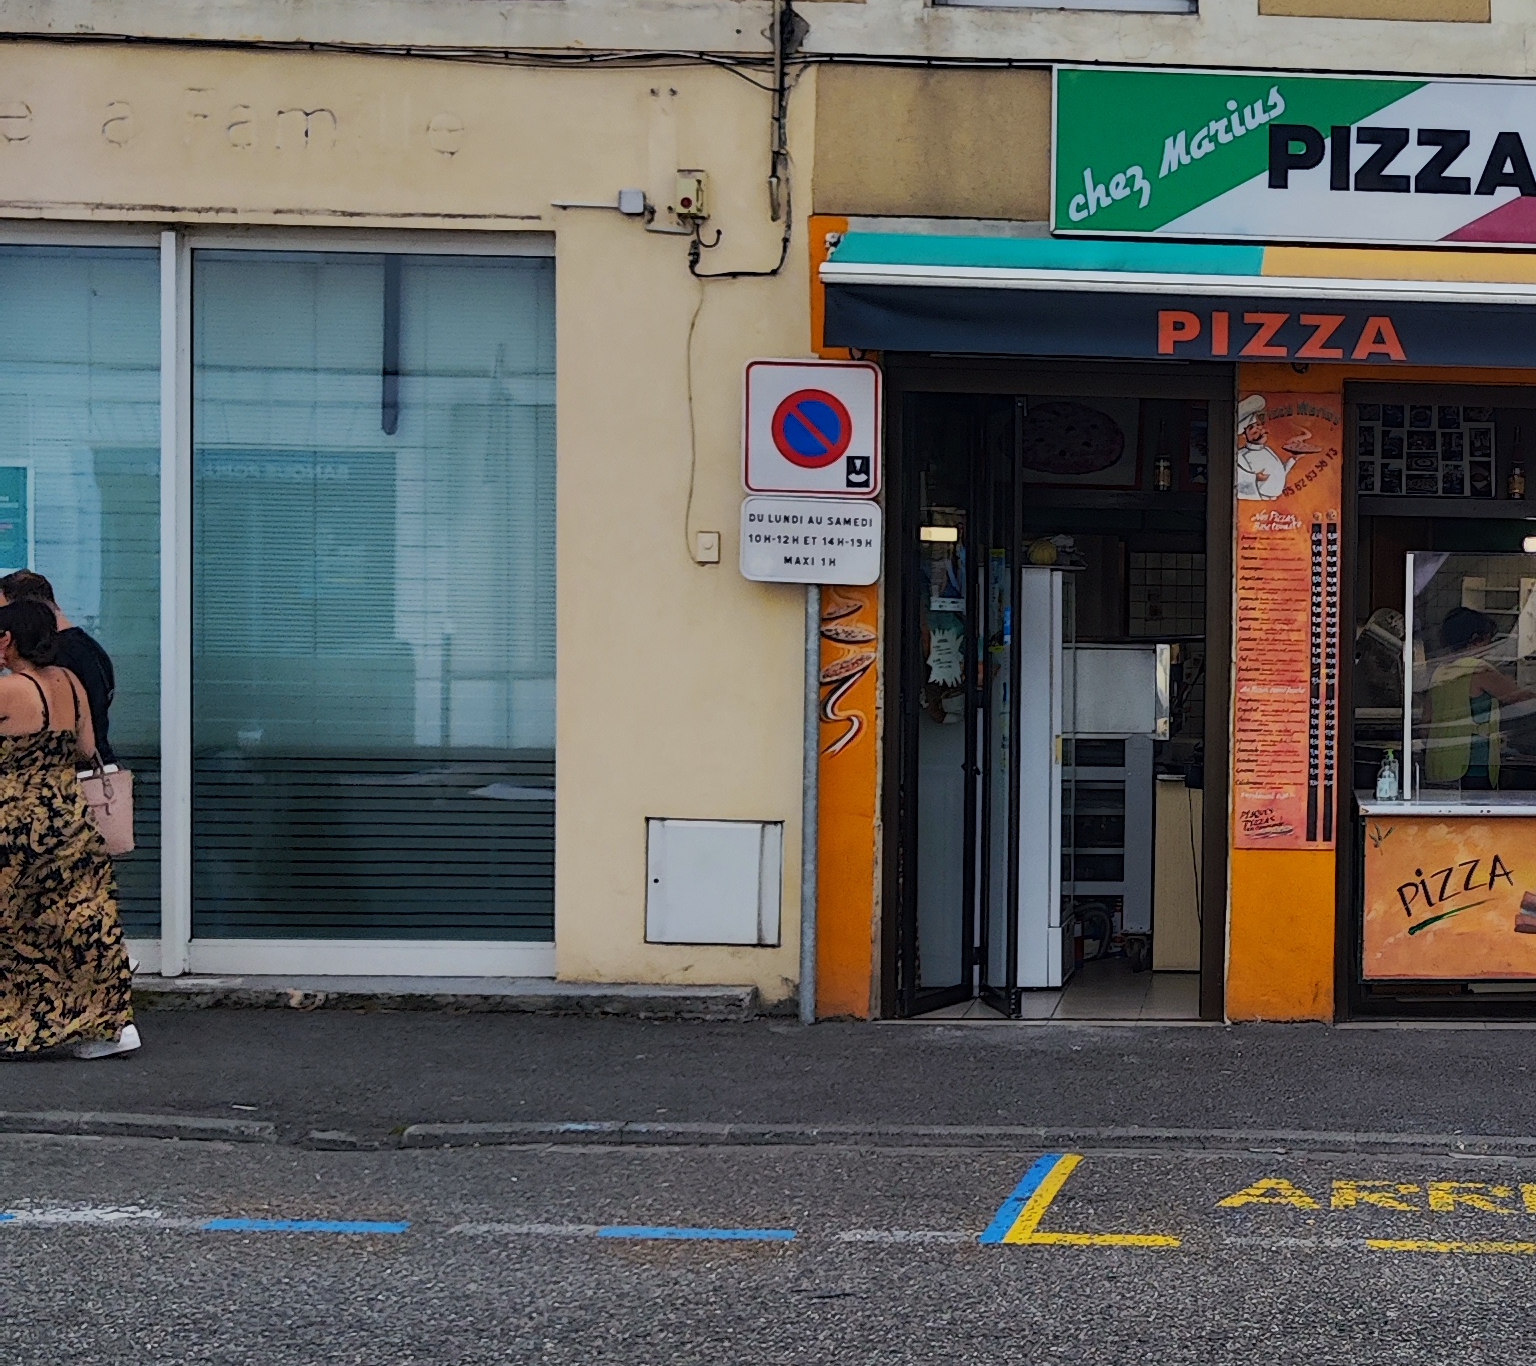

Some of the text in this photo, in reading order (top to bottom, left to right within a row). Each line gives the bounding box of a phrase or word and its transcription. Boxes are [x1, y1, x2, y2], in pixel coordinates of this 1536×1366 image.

[1068, 85, 1286, 222] chez Marius
[1157, 310, 1407, 360] PIZZA
[748, 513, 873, 527] DU LUNDI AU SAMEDI
[804, 536, 817, 545] ET
[784, 556, 815, 566] MAXI
